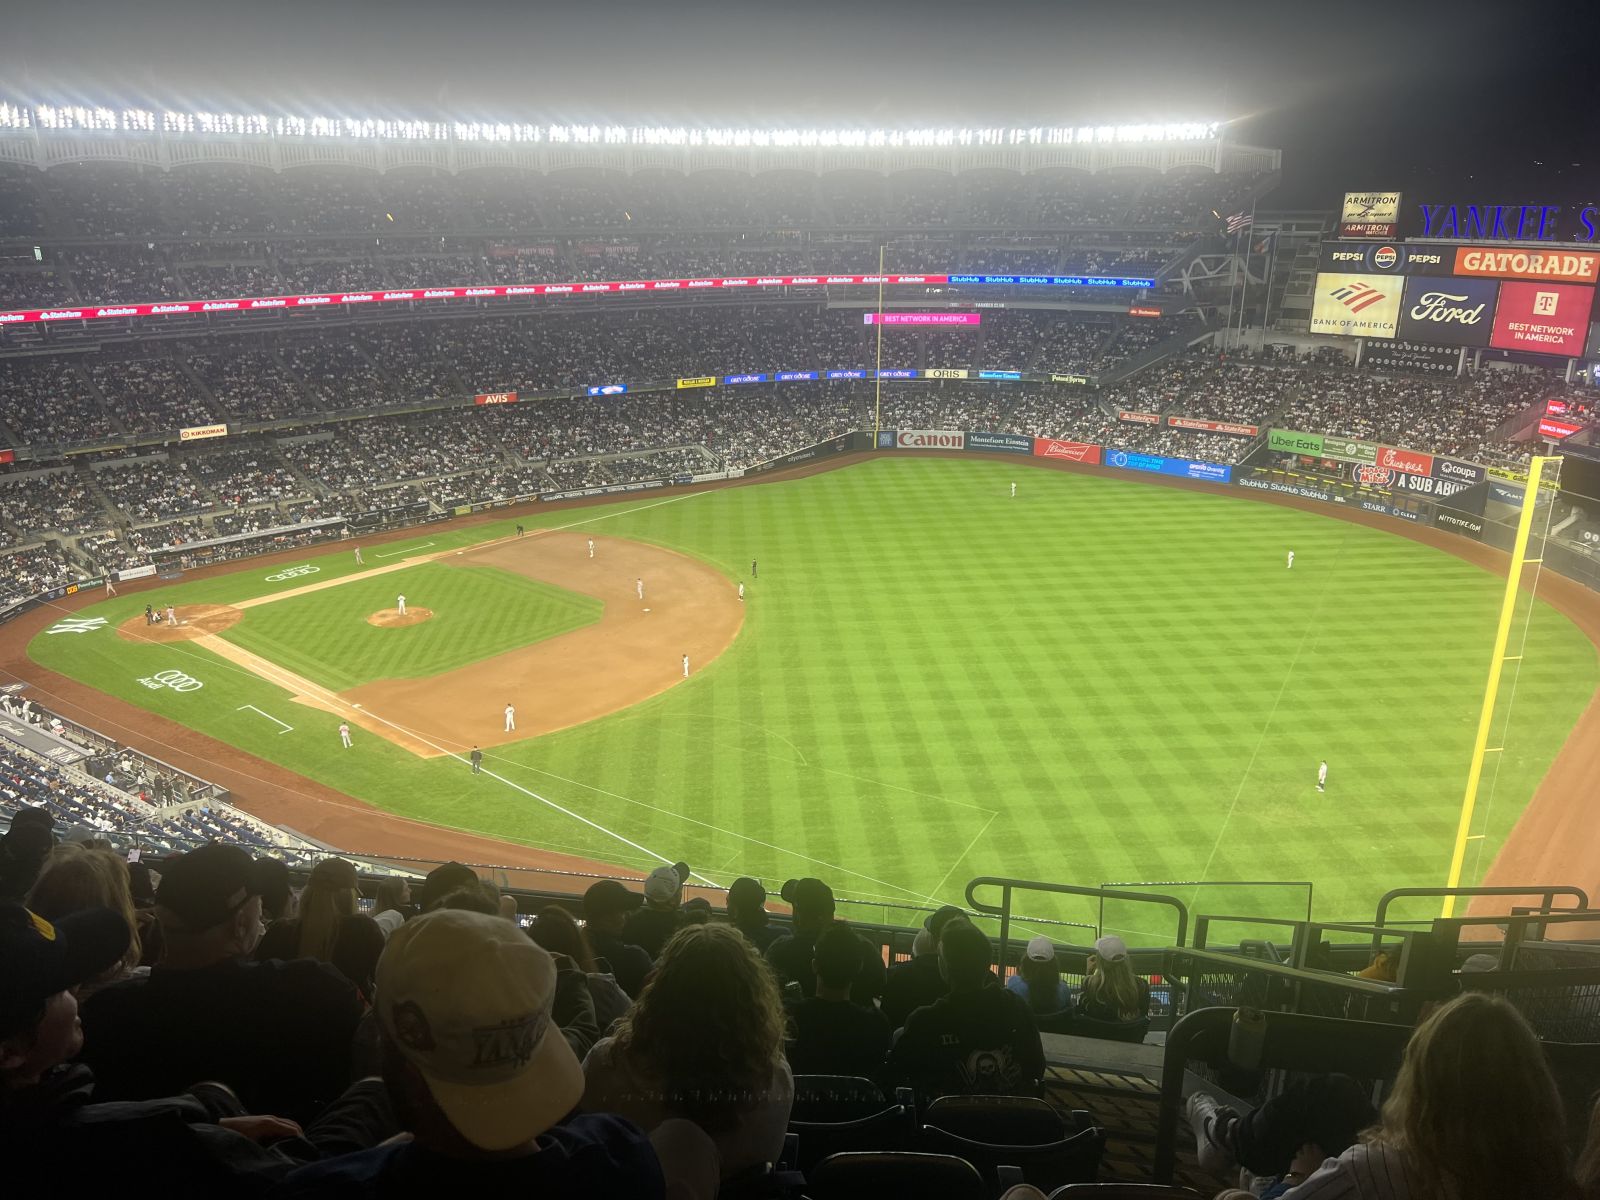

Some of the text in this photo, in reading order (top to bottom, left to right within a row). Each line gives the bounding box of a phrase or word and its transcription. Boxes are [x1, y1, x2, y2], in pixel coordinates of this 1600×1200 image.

[1346, 196, 1397, 205] ARMITRON
[1419, 204, 1561, 241] YANKEE
[1332, 252, 1364, 262] PEPSI
[1408, 254, 1440, 264] PEPSI
[1463, 252, 1594, 277] GATORADE
[1410, 292, 1486, 325] Ford
[1352, 321, 1394, 330] AMERICA
[1508, 322, 1574, 336] BEST NETWORK
[1524, 334, 1564, 344] AMERICA
[933, 369, 960, 378] ORIS
[485, 394, 508, 404] AVIS
[1183, 420, 1209, 429] StateFarm
[1224, 424, 1251, 434] StateFarm
[190, 428, 225, 436] KIKKOMAN
[898, 432, 963, 448] Canon
[970, 435, 1004, 444] Montefiore
[1005, 436, 1028, 446] Einstein
[1271, 436, 1296, 447] Uber
[1296, 440, 1320, 451] Eats
[1050, 445, 1084, 456] Budweiser
[1358, 465, 1390, 478] Jersey
[1453, 466, 1476, 478] coupa
[1488, 469, 1508, 478] Gillette
[1240, 478, 1268, 490] StubHub
[1513, 474, 1528, 483] Gille
[1270, 483, 1298, 494] StubHub
[1398, 474, 1406, 488] A
[1409, 476, 1432, 493] SUB
[1434, 480, 1467, 496] ABO
[1300, 489, 1328, 500] StubHub
[1363, 502, 1386, 513] STARR
[1438, 514, 1482, 533] NITTOTIRE.COM
[136, 678, 164, 690] Audi
